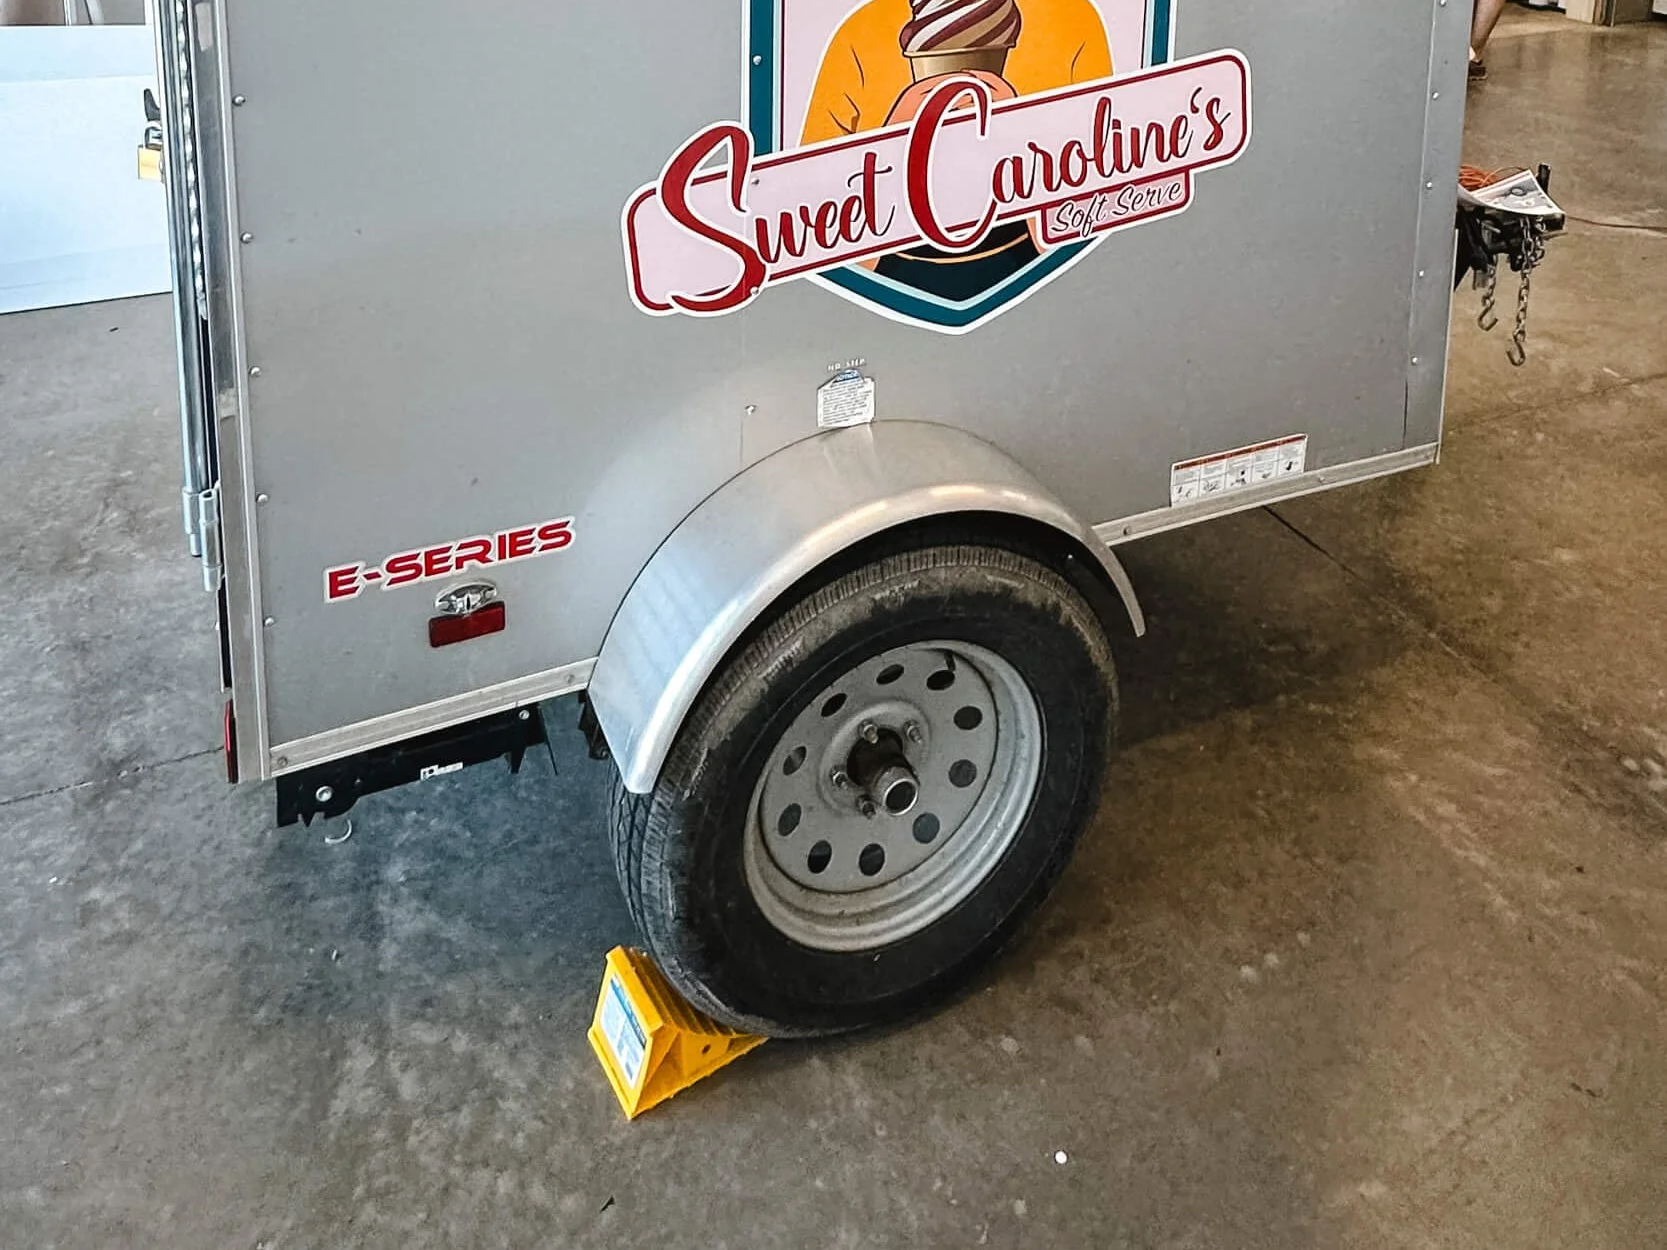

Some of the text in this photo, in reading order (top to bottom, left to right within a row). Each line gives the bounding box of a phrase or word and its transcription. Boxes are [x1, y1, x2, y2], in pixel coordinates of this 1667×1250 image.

[660, 81, 1232, 313] Sweet Caroline's
[1051, 182, 1182, 238] Soft Serve
[328, 519, 573, 599] E-SERIES
